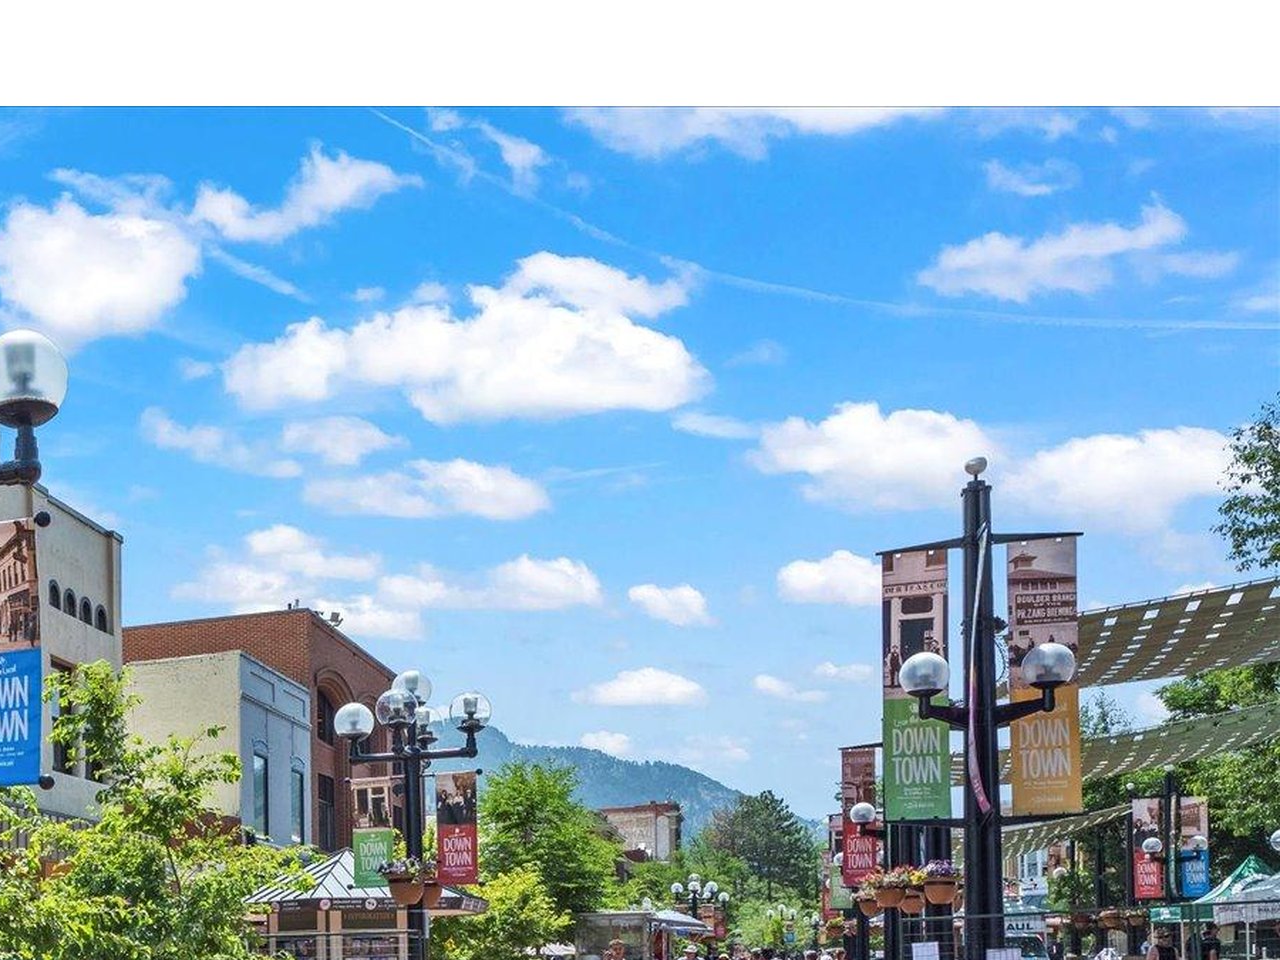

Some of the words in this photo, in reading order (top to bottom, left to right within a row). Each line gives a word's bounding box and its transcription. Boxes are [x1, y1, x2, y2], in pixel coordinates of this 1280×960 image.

[1019, 718, 1071, 748] DOWN
[892, 727, 941, 755] DOWN
[892, 756, 942, 785] TOWN
[1019, 747, 1071, 779] TOWN
[360, 841, 387, 856] DOWN
[443, 836, 471, 851] DOWN
[847, 838, 872, 853] DOWN
[445, 851, 472, 866] TOWN
[847, 852, 873, 869] TOWN
[1137, 862, 1157, 873] DOWN
[1185, 861, 1205, 872] DOWN
[1138, 874, 1157, 885] TOWN
